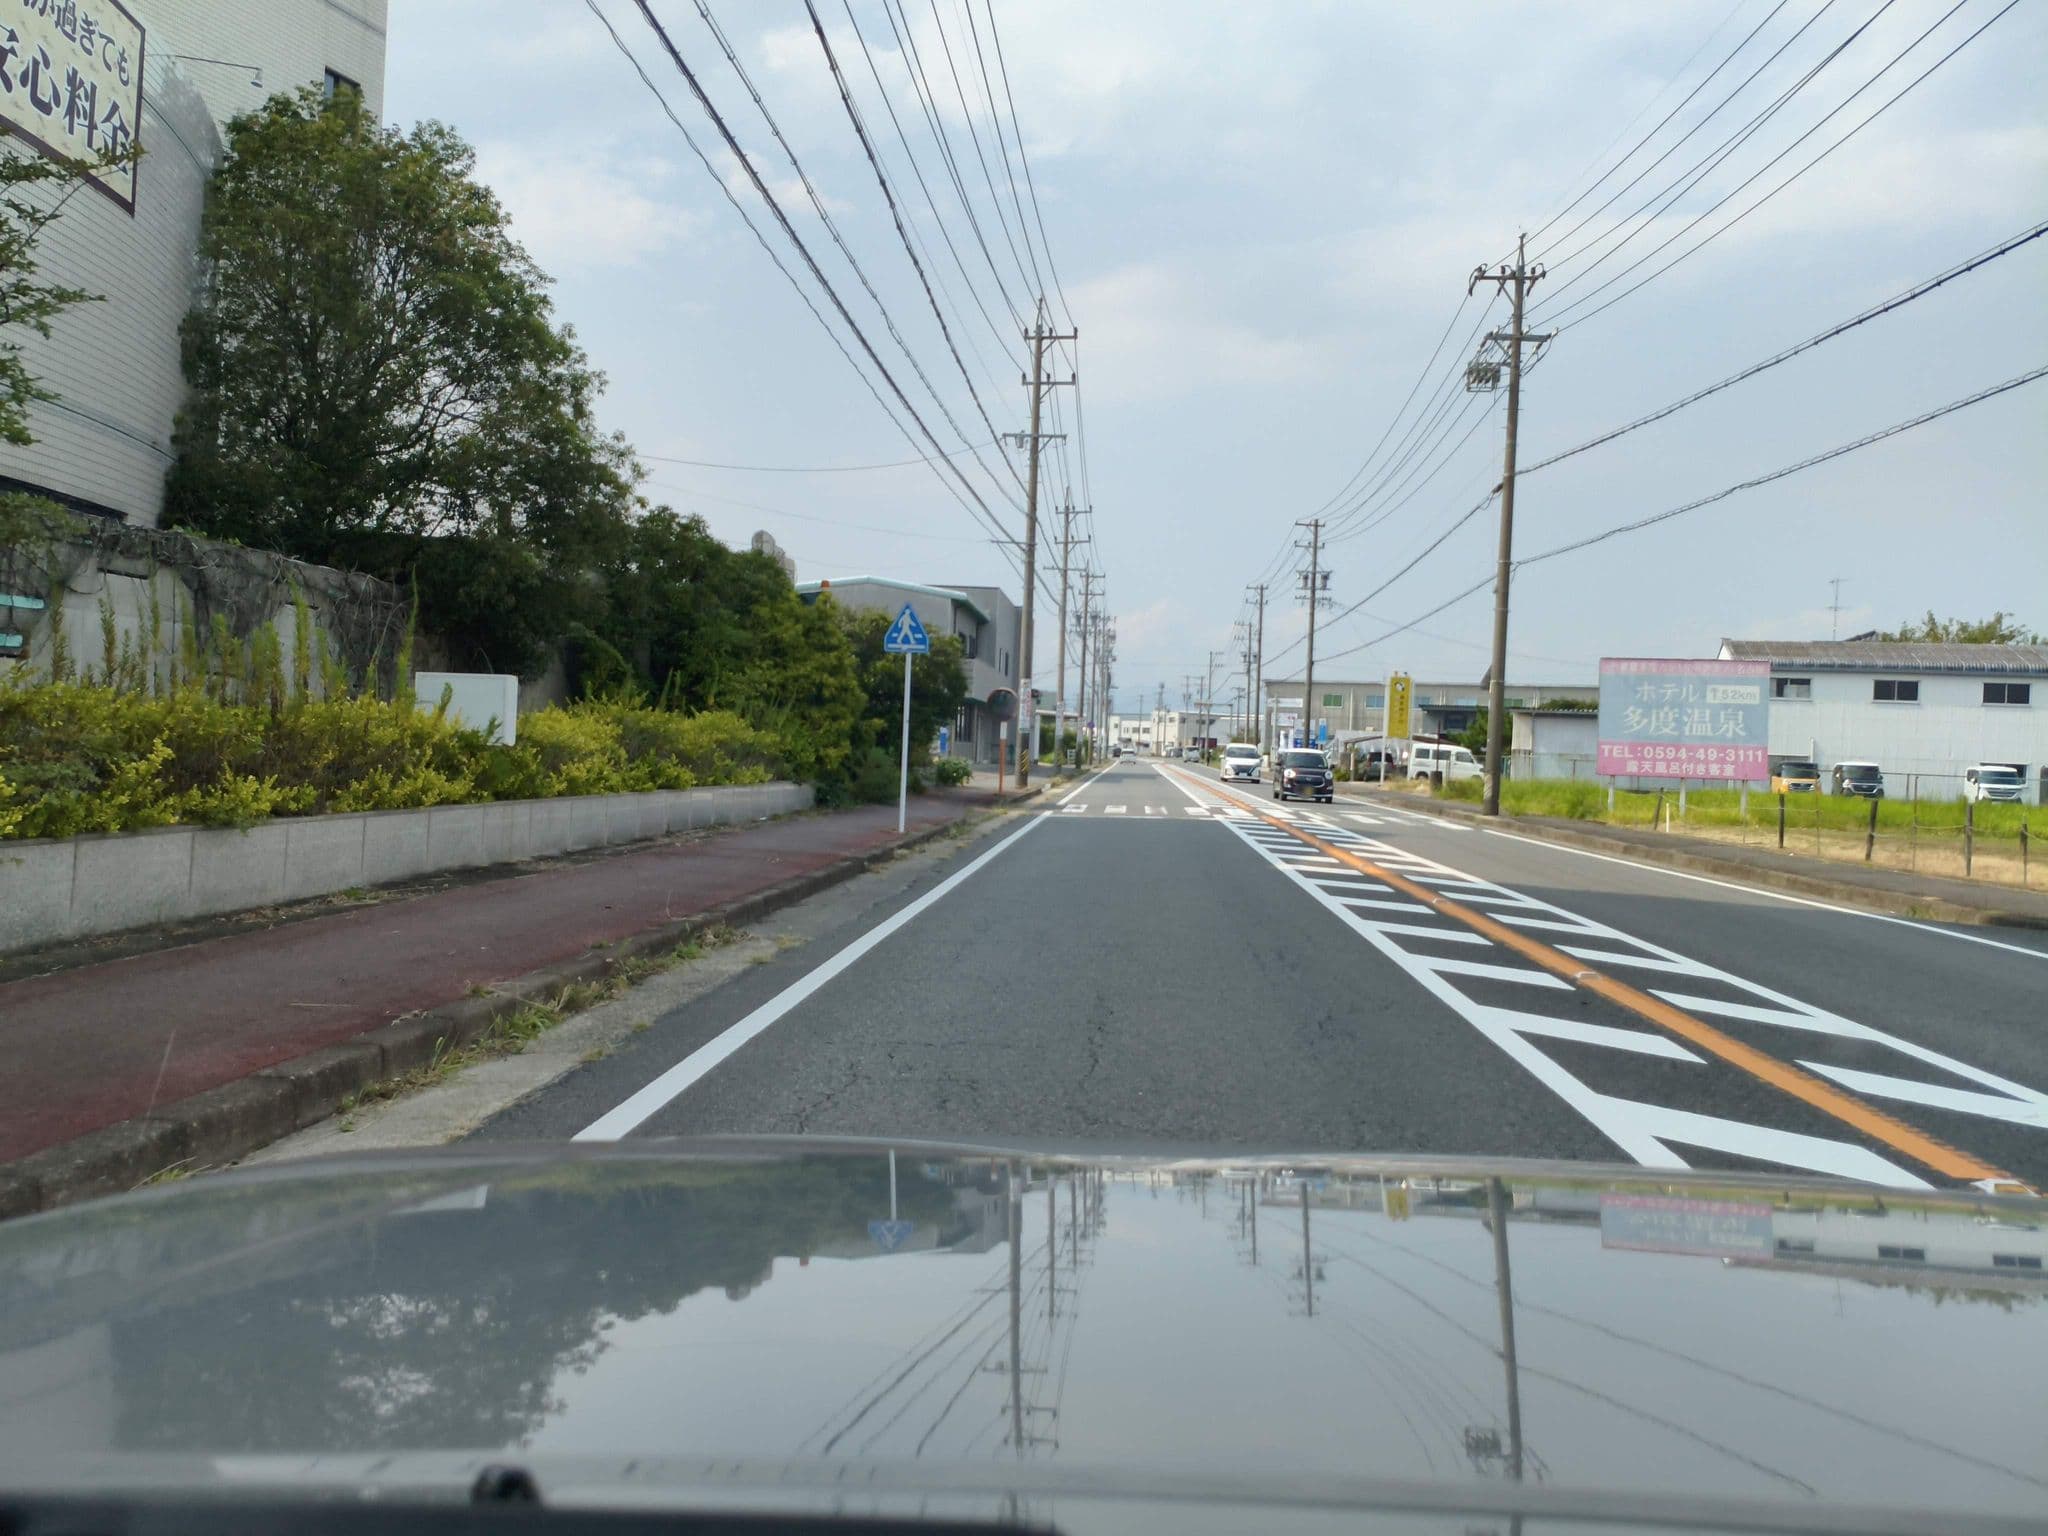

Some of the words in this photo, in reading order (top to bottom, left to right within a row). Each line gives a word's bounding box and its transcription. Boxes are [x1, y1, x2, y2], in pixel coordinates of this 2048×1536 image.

[1635, 681, 1699, 703] ホテル
[1623, 705, 1747, 737] 多度温泉
